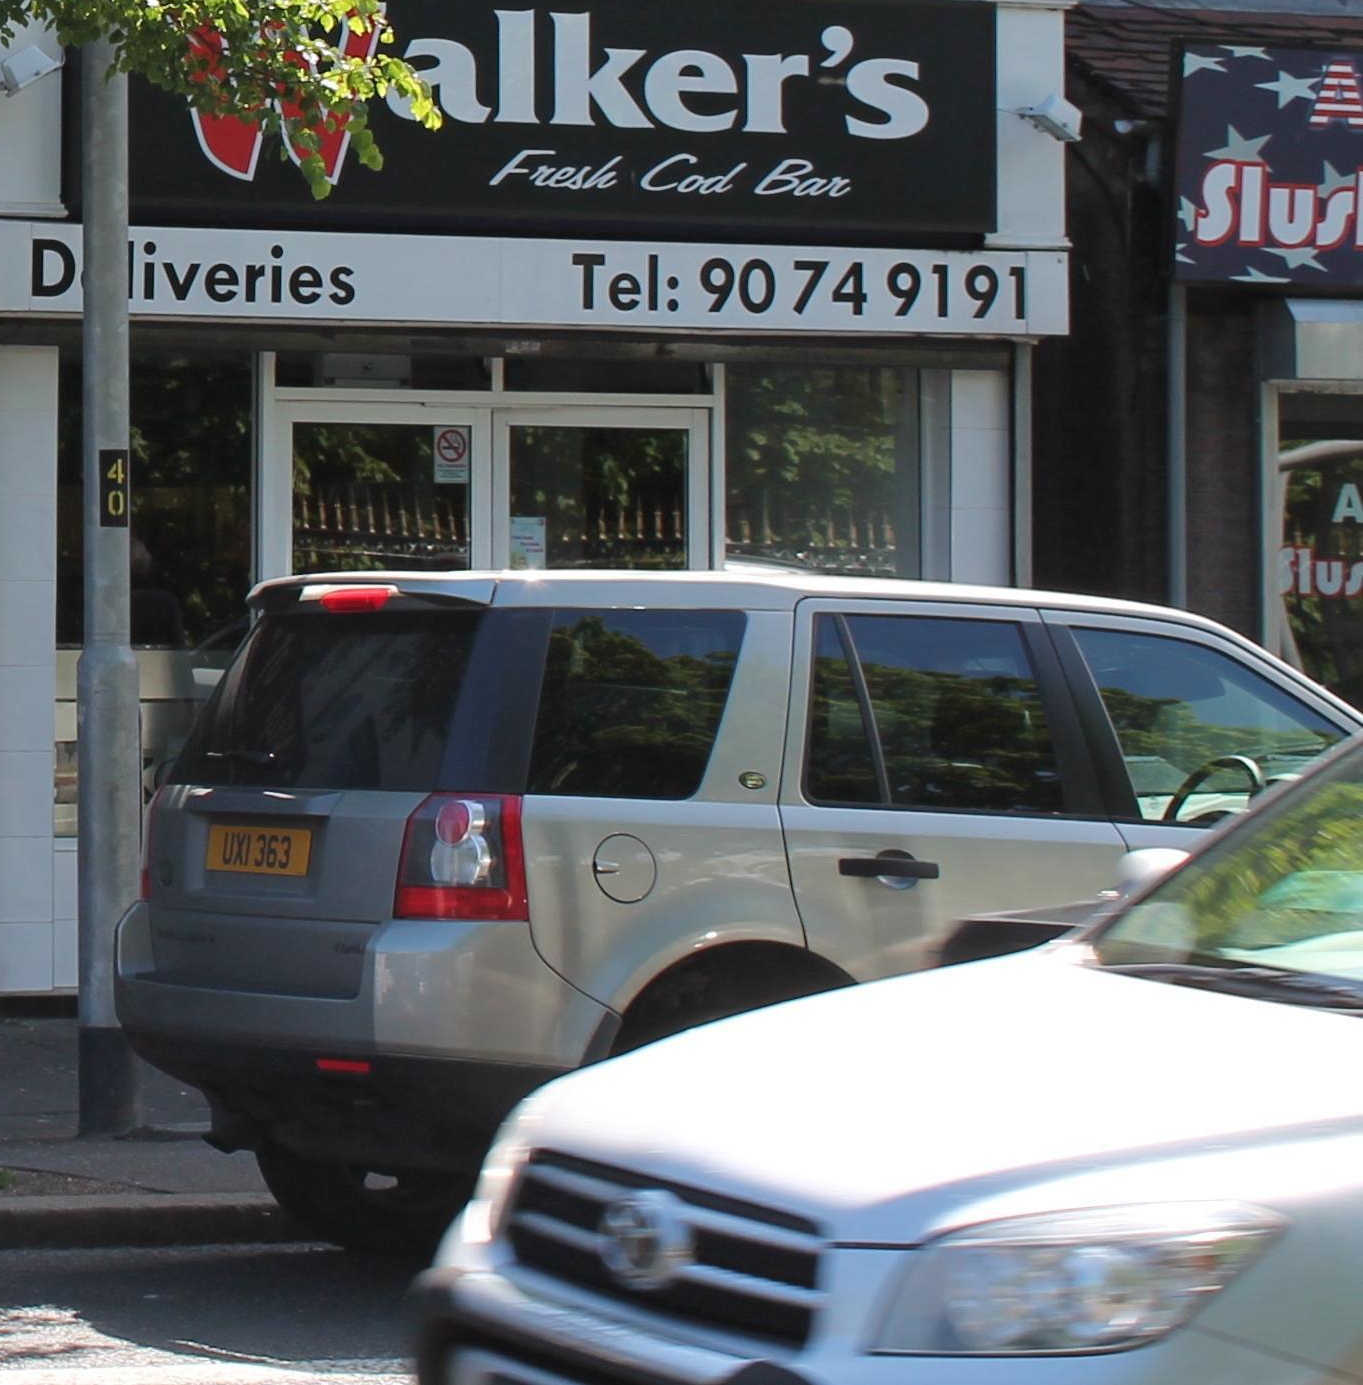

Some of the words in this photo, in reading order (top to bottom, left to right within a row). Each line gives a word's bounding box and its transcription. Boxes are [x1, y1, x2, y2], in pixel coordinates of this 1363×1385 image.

[488, 148, 625, 191] Fresh
[639, 152, 747, 196] Cod
[754, 158, 853, 199] Bar
[1194, 159, 1363, 251] Slus
[30, 237, 356, 306] Dliveries
[572, 253, 680, 313] Tel:
[221, 831, 252, 867] UXI
[253, 833, 292, 870] 363
